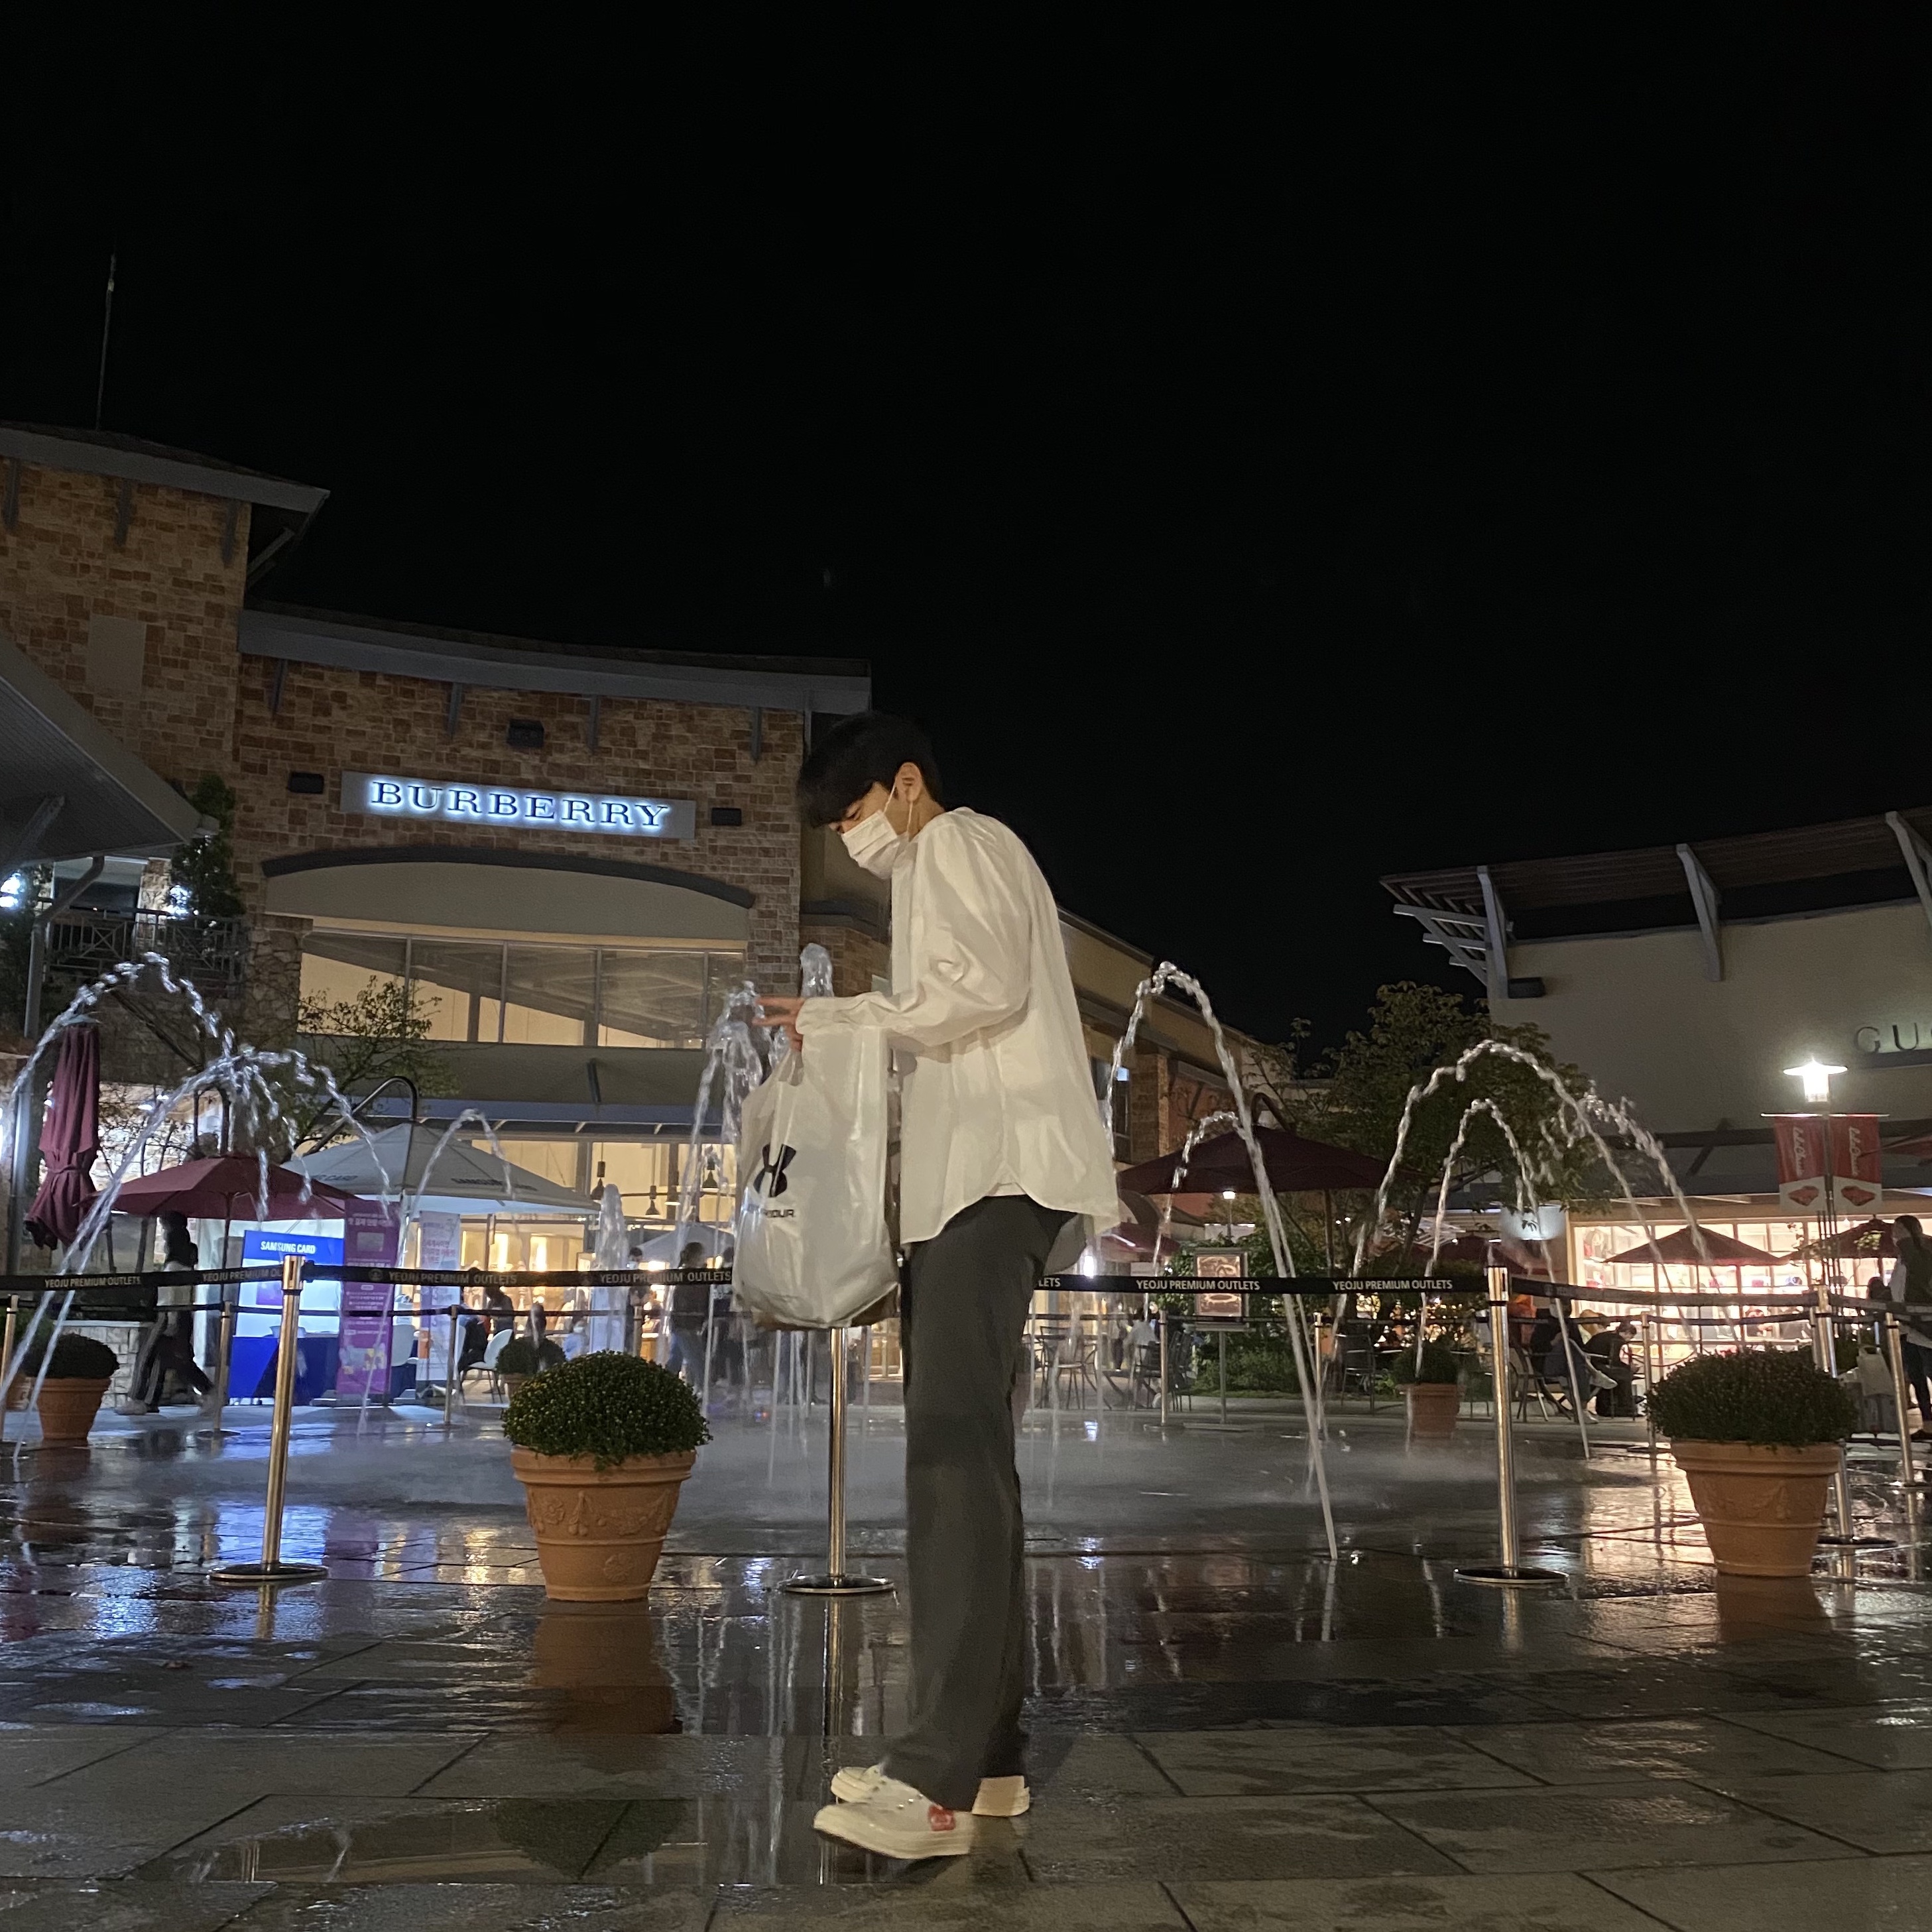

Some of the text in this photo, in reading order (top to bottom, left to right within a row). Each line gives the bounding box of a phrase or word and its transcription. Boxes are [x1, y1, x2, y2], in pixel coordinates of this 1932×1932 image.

[371, 780, 668, 827] BURBERRY
[1854, 1022, 1932, 1054] GU
[261, 1240, 316, 1254] SAMSUNG CARD
[44, 1276, 141, 1288] YEOJU PREMIUM OUTLETS
[202, 1272, 228, 1282] YEOJU
[229, 1269, 269, 1280] PREMIUM
[389, 1271, 517, 1284] YEOJU PREMIUM OUTLETS
[600, 1273, 630, 1284] YEOJU
[688, 1271, 731, 1282] OUTLETS
[1038, 1277, 1061, 1287] LETS
[1136, 1280, 1260, 1290] YEOJU PREMIUM OUTLETS
[1333, 1280, 1453, 1290] YEOJU PREMIUM OUTLETS
